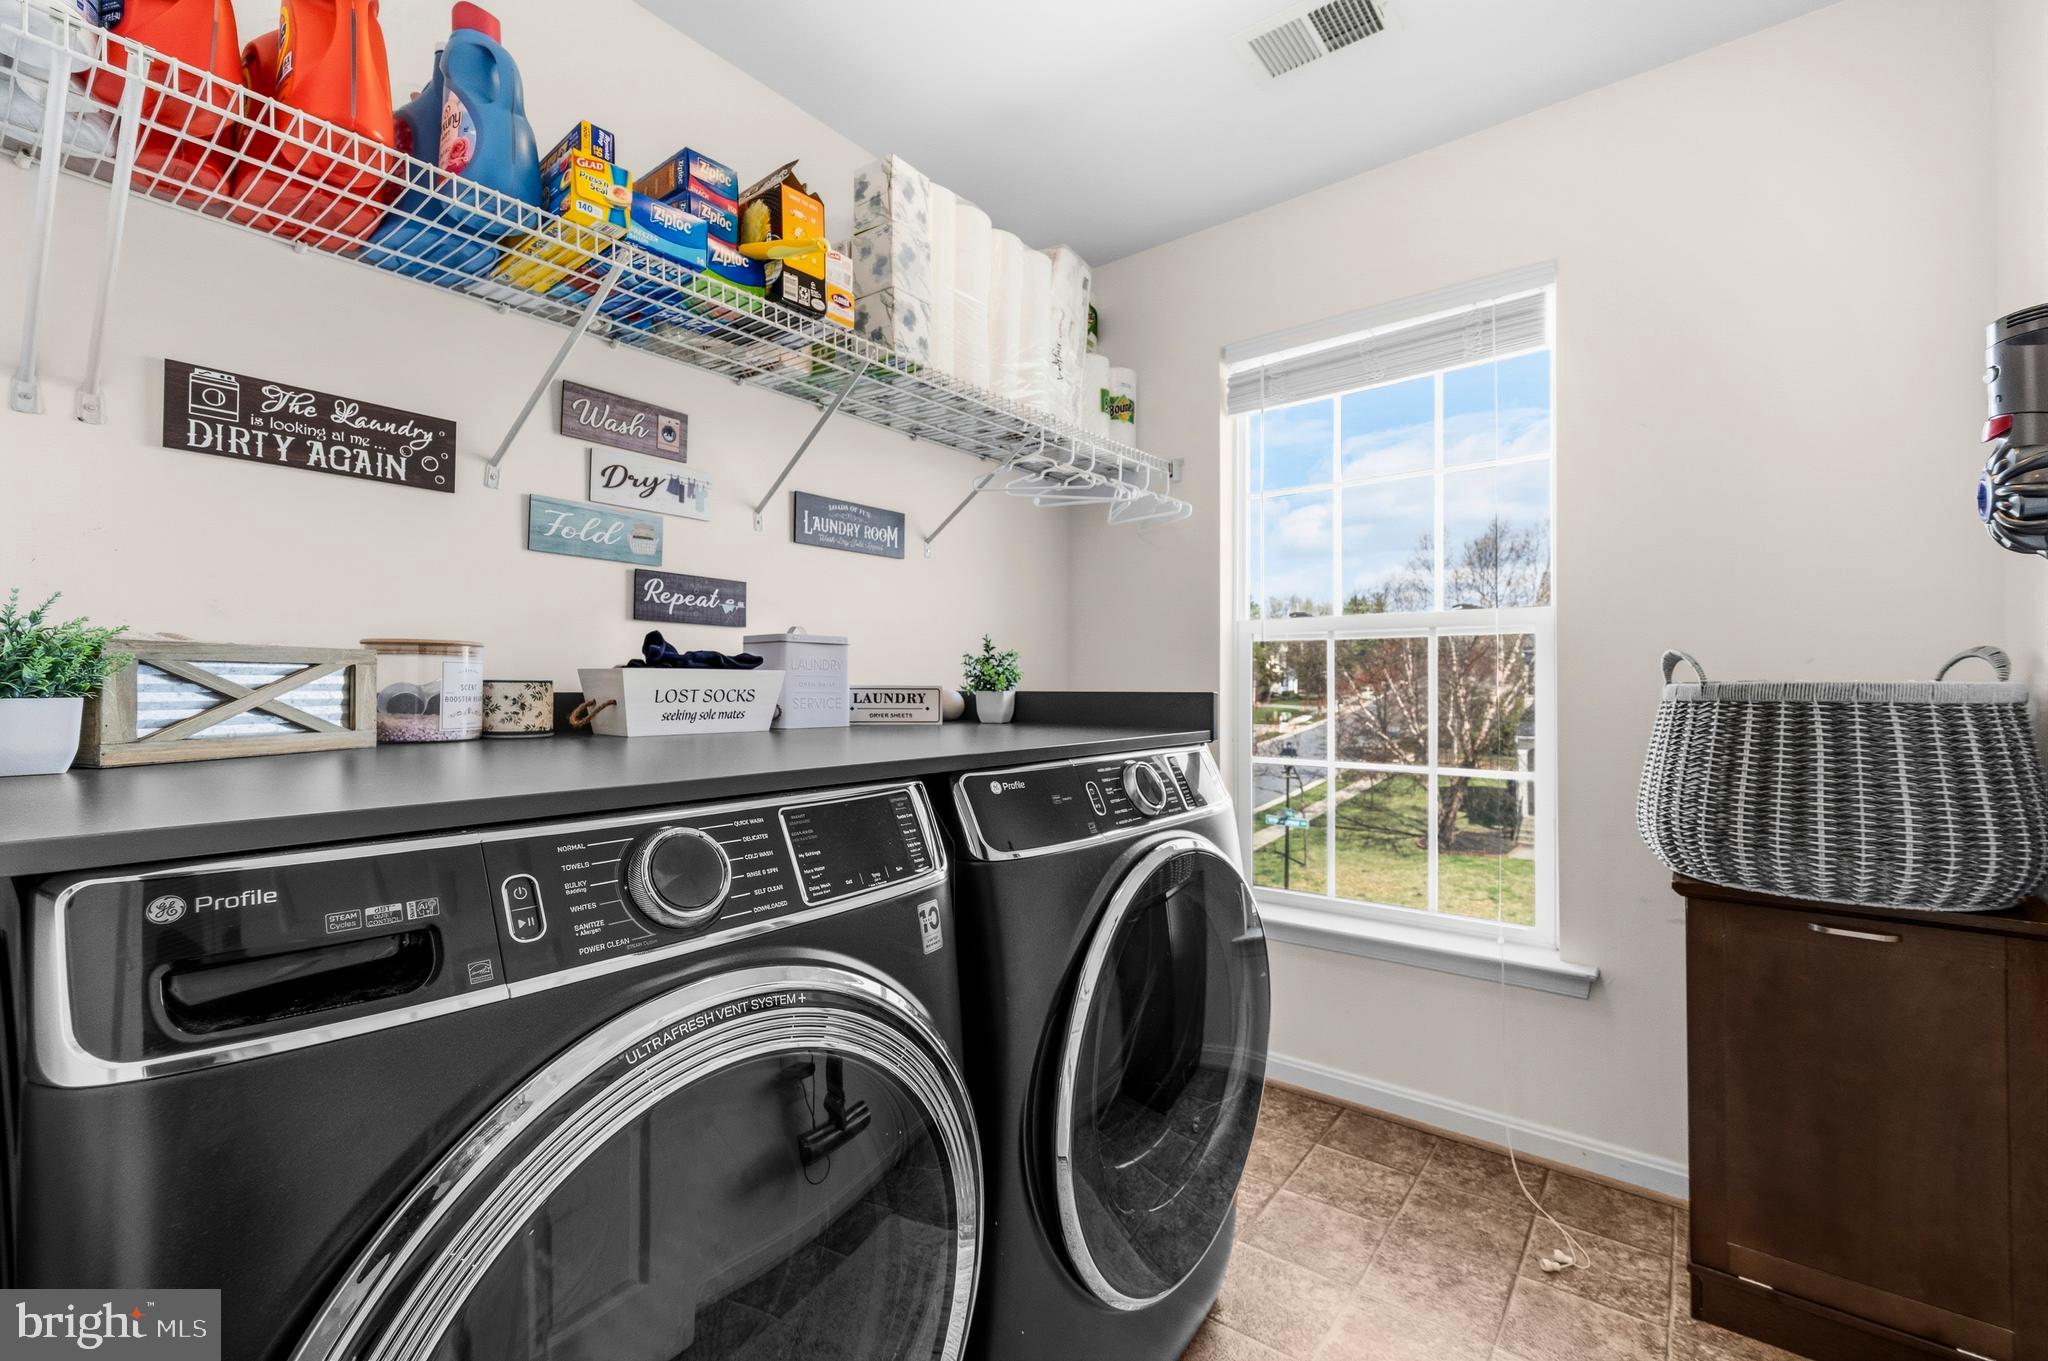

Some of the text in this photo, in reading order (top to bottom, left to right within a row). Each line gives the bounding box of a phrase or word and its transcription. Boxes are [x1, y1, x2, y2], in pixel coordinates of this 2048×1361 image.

[576, 158, 604, 171] GLAD
[699, 160, 732, 187] Ziploc
[590, 183, 608, 196] Seal
[578, 201, 592, 212] 140
[653, 206, 692, 234] Ziploc
[700, 204, 732, 232] Ziploc
[712, 247, 749, 268] Ziploc
[262, 384, 433, 450] The Laundry
[572, 399, 649, 438] Wash
[250, 413, 264, 427] is
[270, 416, 327, 441] looking
[187, 419, 407, 481] DIRTY AGAIN
[601, 464, 666, 498] Dry
[544, 509, 625, 545] Fold
[804, 510, 898, 548] LAUNDRY ROOM
[644, 578, 721, 615] Repeat
[791, 659, 844, 671] LAUNDRY
[654, 688, 755, 703] LOST SOCKS
[853, 692, 926, 704] LAUNDRY
[792, 697, 842, 710] SERVICE
[661, 708, 746, 724] seeking sole mates
[1002, 780, 1026, 792] Profile
[557, 843, 586, 853] NORMAL
[744, 852, 758, 860] COLD
[561, 861, 590, 872] TOWELS
[564, 880, 587, 890] BULKY
[194, 888, 278, 912] Profile
[570, 902, 597, 912] WHITES
[754, 900, 788, 913] DOWNLOADED
[329, 912, 358, 922] STEAM
[330, 920, 357, 930] Cycles
[574, 920, 605, 932] SANITIZE
[579, 938, 630, 956] POWER CLEAN
[626, 1012, 715, 1065] ULTRAFRESH
[716, 1001, 749, 1022] VENT
[750, 993, 796, 1010] SYSTEM
